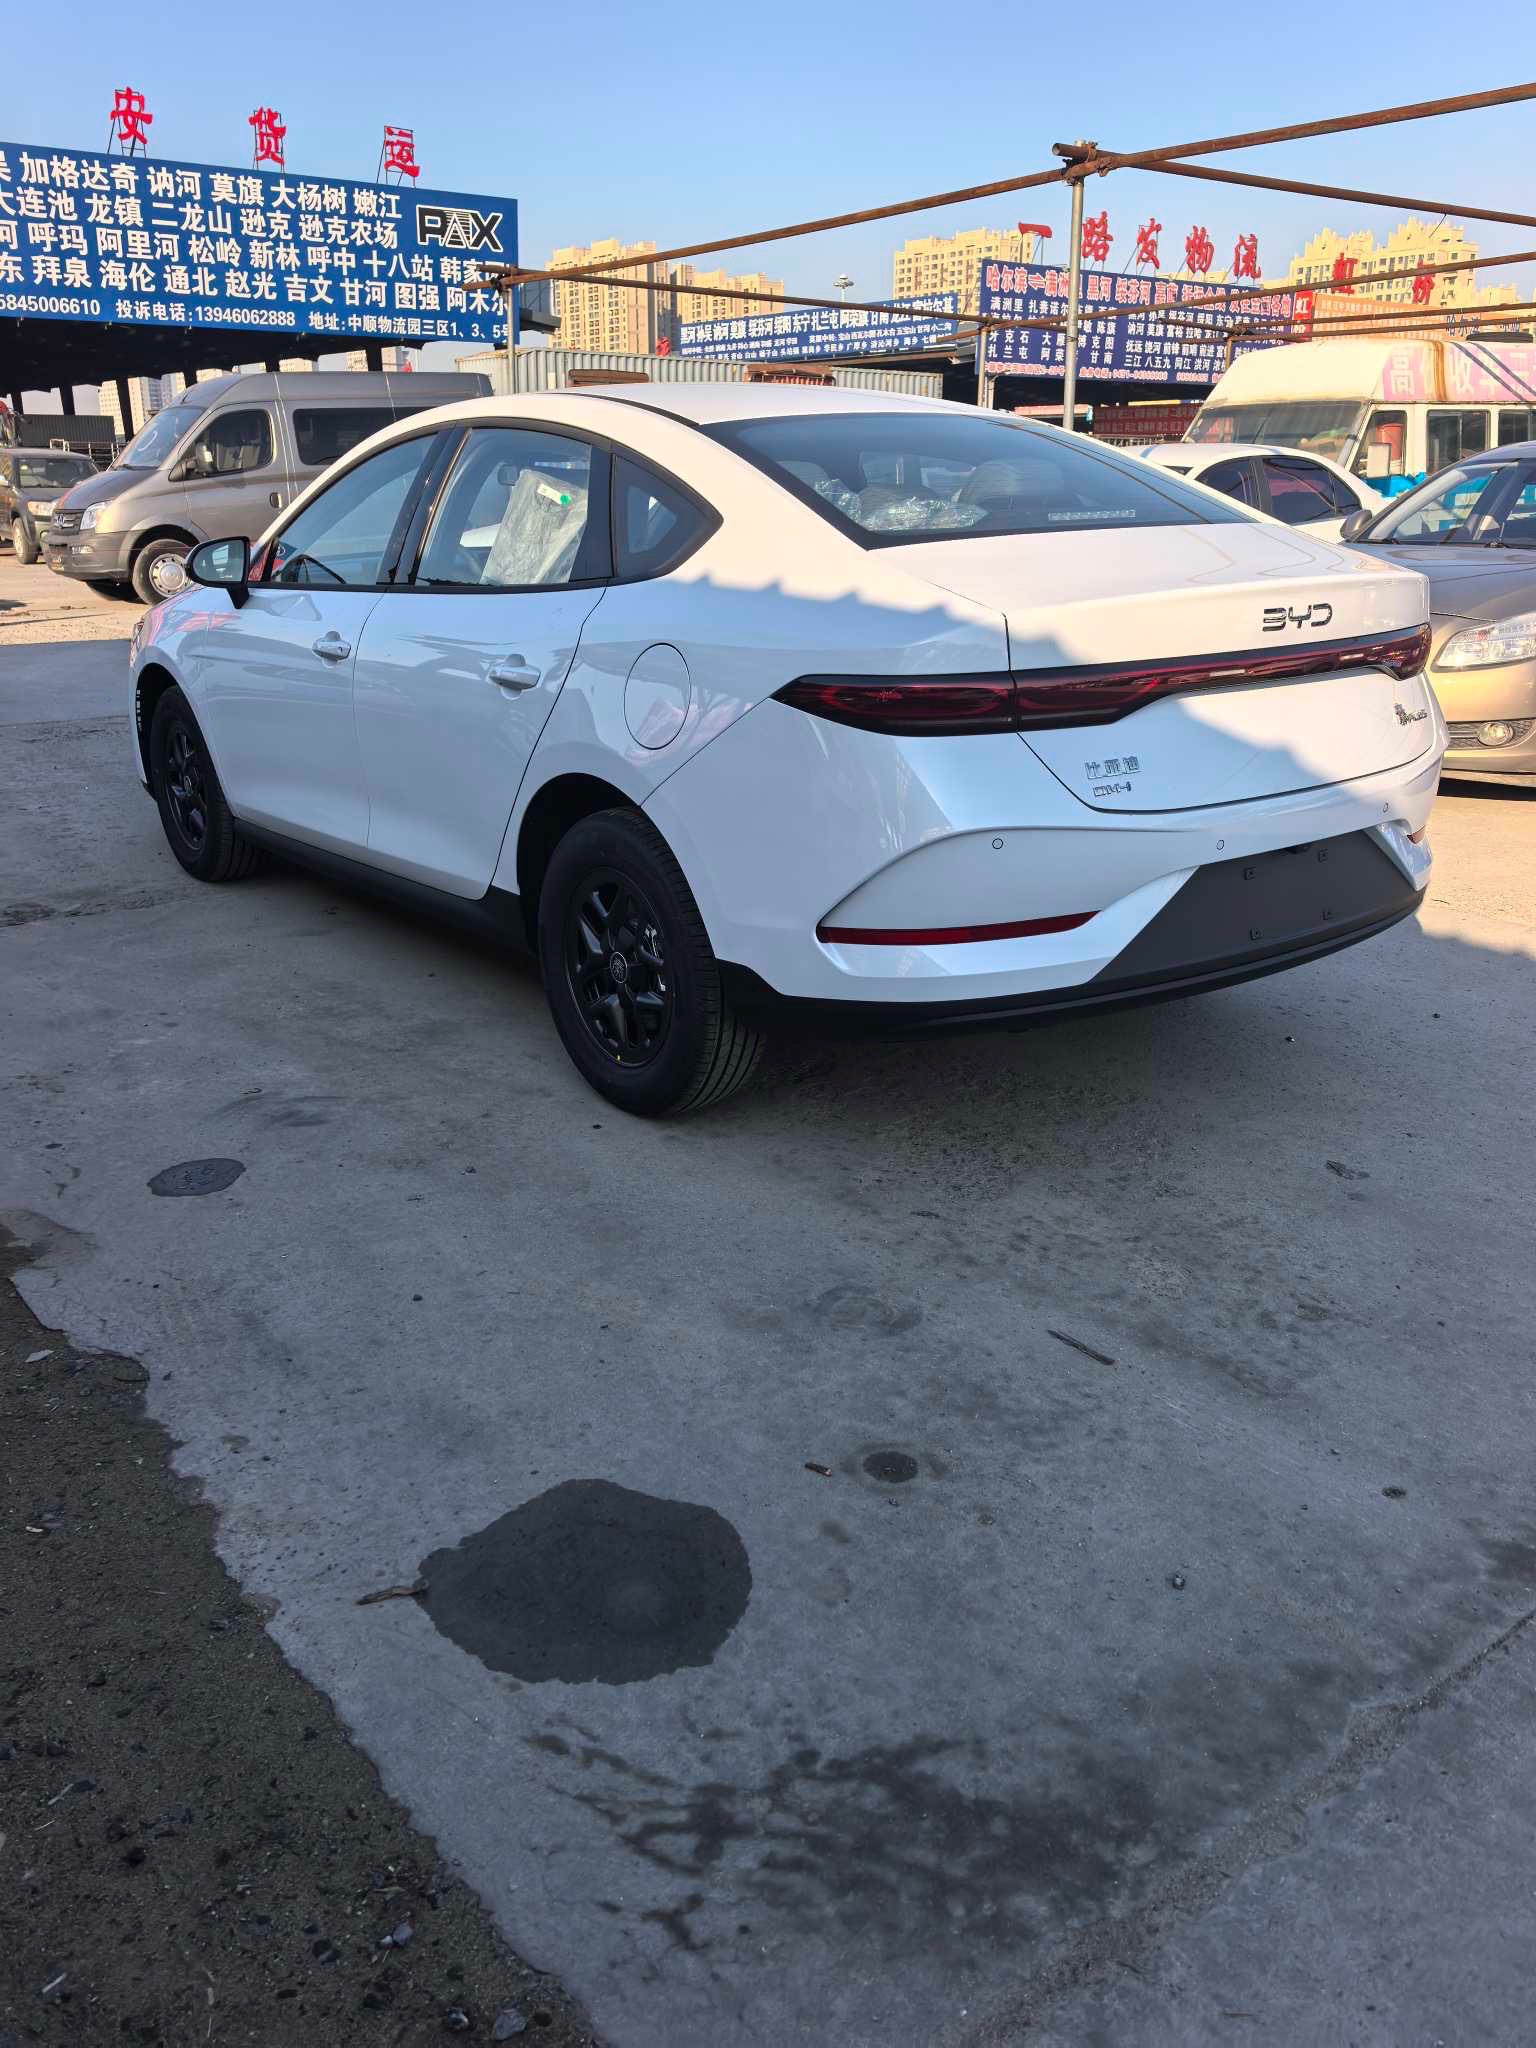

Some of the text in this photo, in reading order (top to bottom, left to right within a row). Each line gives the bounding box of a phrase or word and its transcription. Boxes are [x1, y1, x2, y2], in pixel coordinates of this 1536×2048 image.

[110, 86, 420, 178] 安 货 运
[19, 152, 139, 194] 加格达奇
[147, 166, 202, 200] 讷河
[209, 172, 264, 207] 莫旗
[270, 179, 347, 215] 大杨树
[353, 187, 402, 219] 嫩江
[85, 193, 143, 227] 龙镇
[152, 202, 232, 235] 二龙山
[240, 208, 293, 240] 逊克
[299, 214, 398, 249] 逊克农场
[1018, 211, 1262, 278] 一路发物流
[27, 222, 88, 256] 呼玛
[96, 227, 180, 262] 阿里河
[188, 234, 242, 267] 松岭
[249, 239, 301, 271] 新林
[307, 246, 356, 276] 呼中
[363, 250, 433, 282] 十八站
[0, 293, 100, 315] 5845006610
[31, 254, 92, 288] 拜泉
[99, 259, 156, 292] 海伦
[164, 264, 218, 296] 通北
[225, 268, 277, 300] 赵光
[284, 273, 334, 305] 吉文
[341, 278, 387, 308] 甘河
[394, 282, 440, 311] 图强
[986, 264, 1027, 294] 哈尔滨
[1044, 269, 1082, 299] 满洲
[1087, 275, 1113, 302] 黑河
[1115, 277, 1152, 306] 绥芬河
[990, 296, 1024, 313] 满洲里
[792, 312, 811, 333] 东宁
[811, 310, 839, 331] 扎兰屯
[987, 343, 1029, 360] 扎兰屯
[1090, 350, 1114, 365] 甘南
[1123, 354, 1142, 368] 三江
[1144, 355, 1171, 370] 八五九
[1174, 357, 1192, 370] 同江
[1263, 603, 1333, 632] BYD
